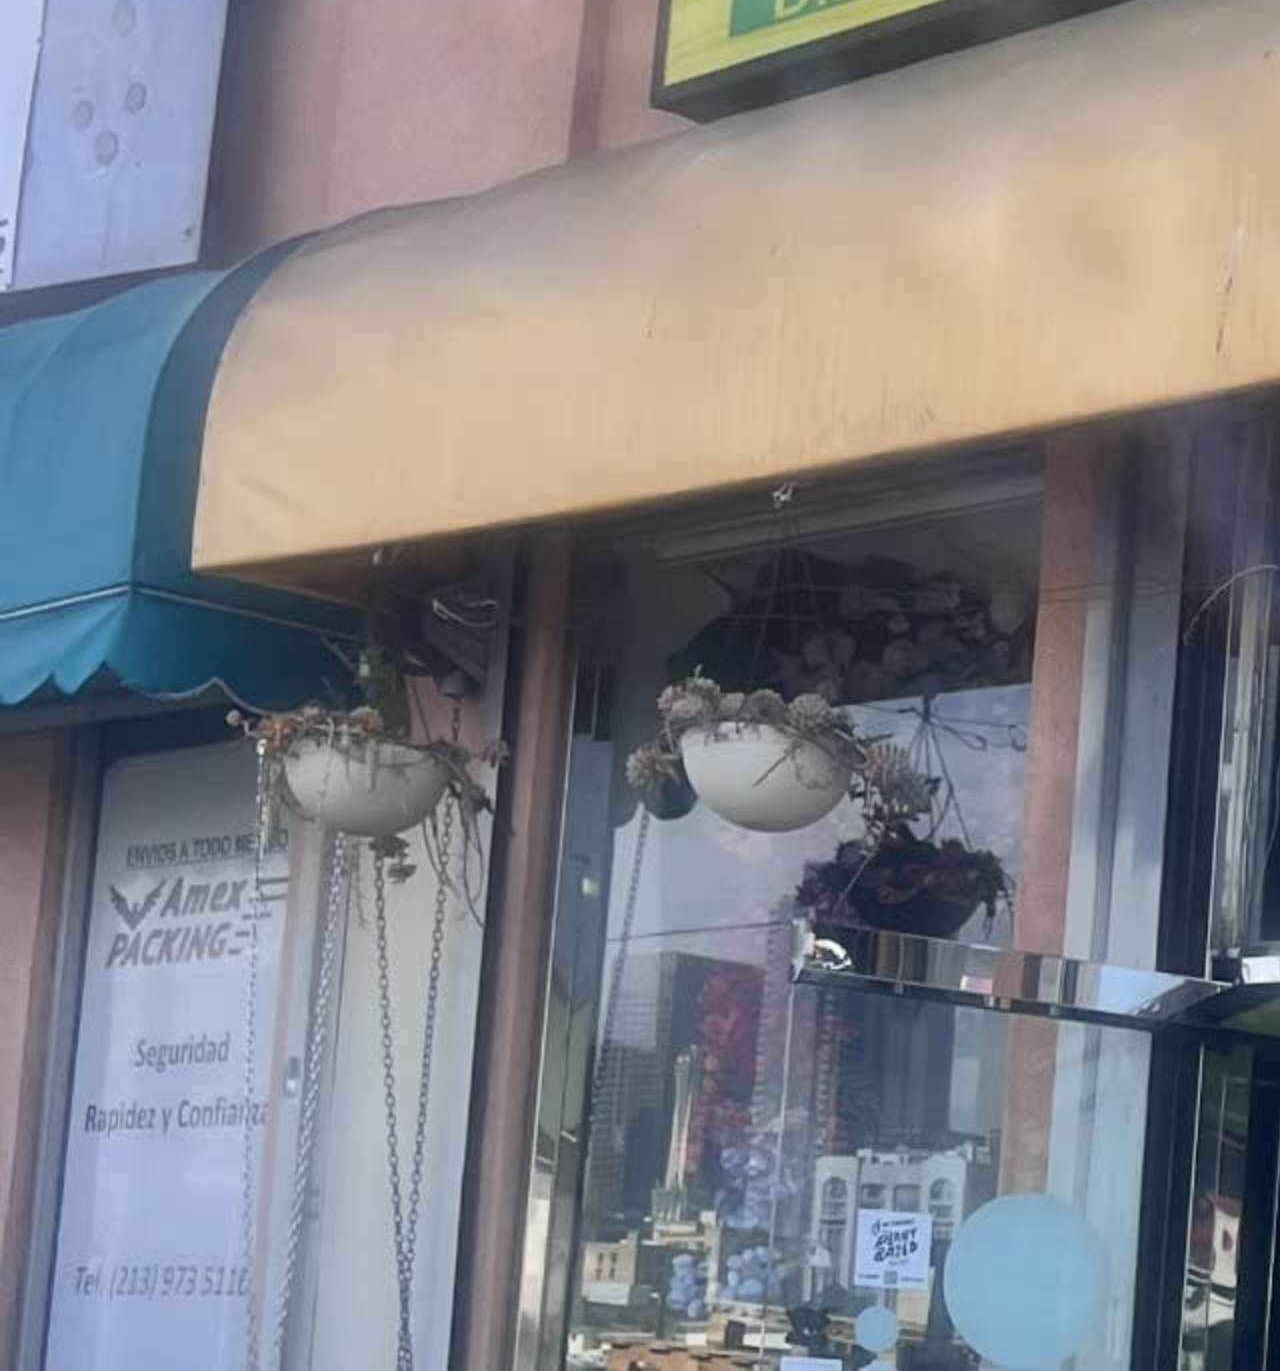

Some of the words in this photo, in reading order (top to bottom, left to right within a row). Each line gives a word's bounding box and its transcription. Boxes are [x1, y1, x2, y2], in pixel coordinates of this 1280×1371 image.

[192, 834, 233, 858] TODO
[160, 876, 249, 918] Amex
[106, 922, 233, 970] PACKING
[134, 1031, 232, 1074] Seguridad
[84, 1099, 156, 1139] Rapidez
[161, 1107, 173, 1138] y
[161, 1265, 198, 1297] 973
